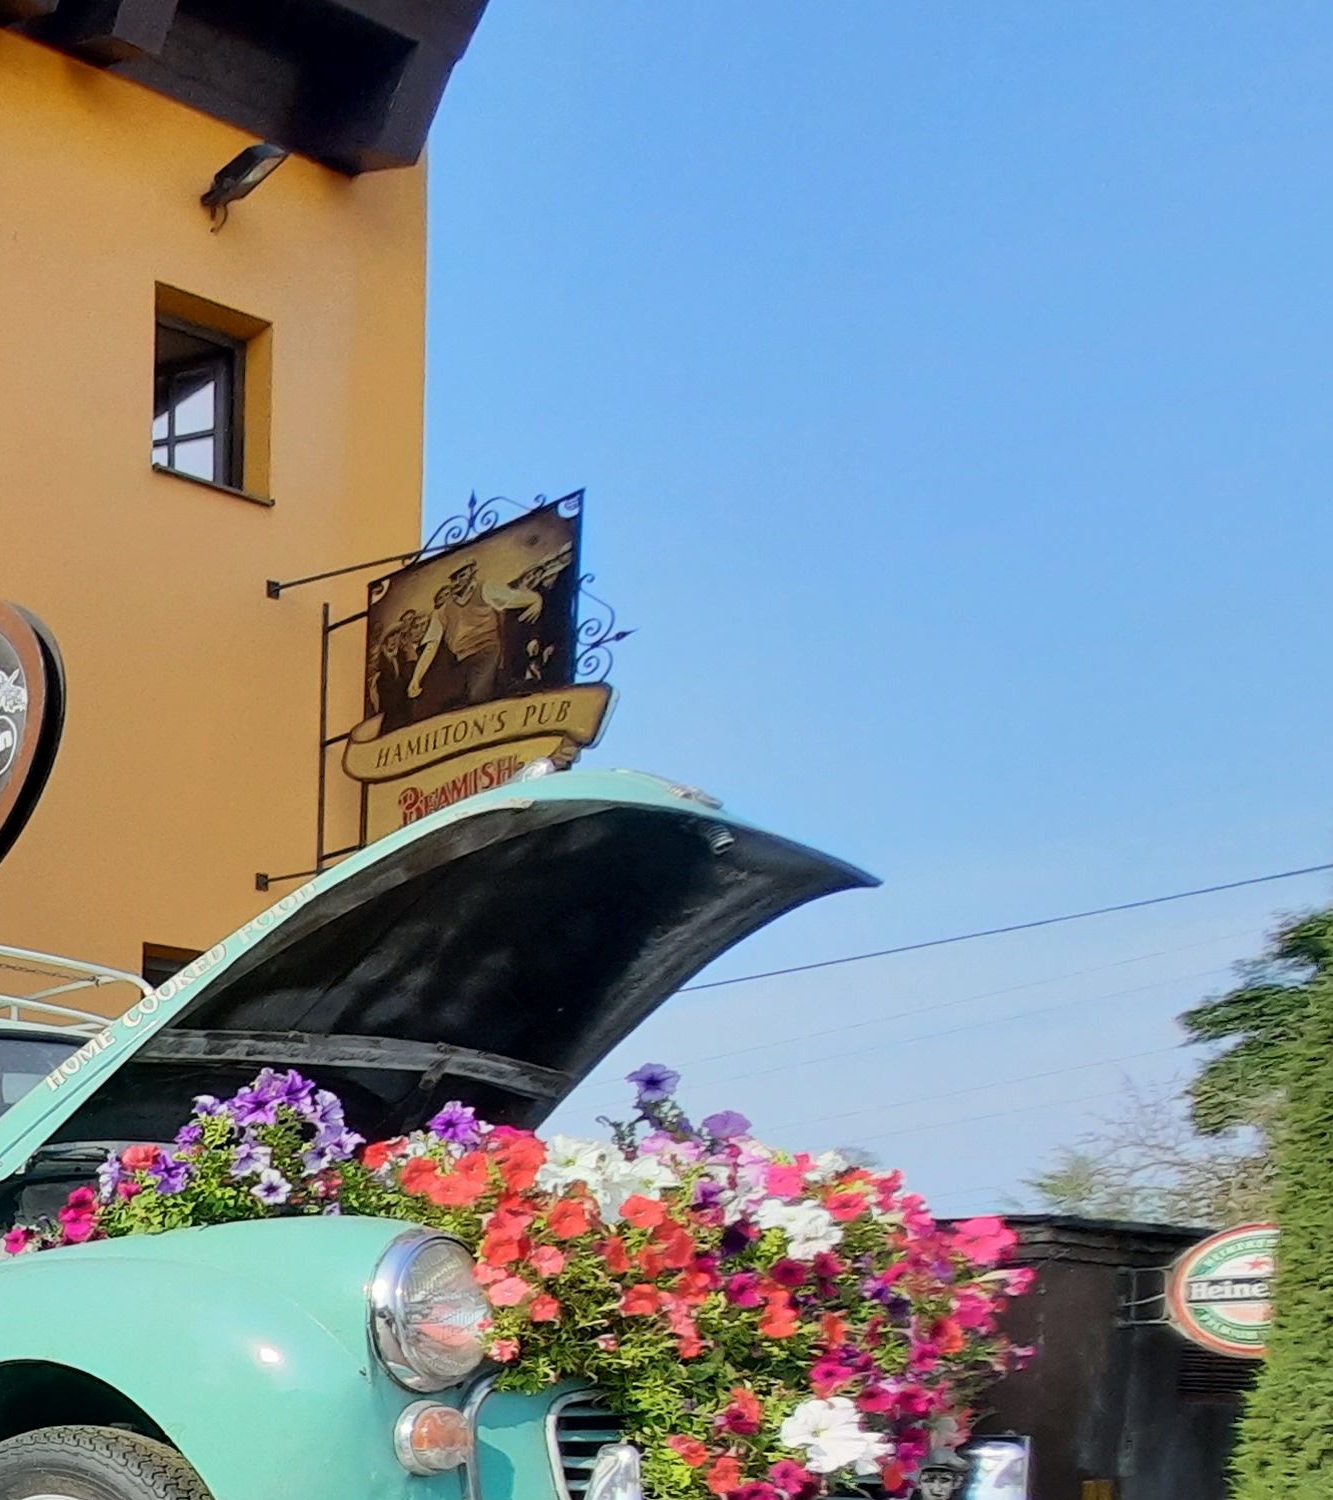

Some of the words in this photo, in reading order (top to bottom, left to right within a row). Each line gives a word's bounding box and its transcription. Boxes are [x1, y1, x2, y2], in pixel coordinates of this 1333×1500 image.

[375, 710, 508, 769] HAMILTON'S
[522, 701, 572, 727] PUB
[45, 1031, 117, 1092] HOME
[122, 943, 226, 1028] COOKED
